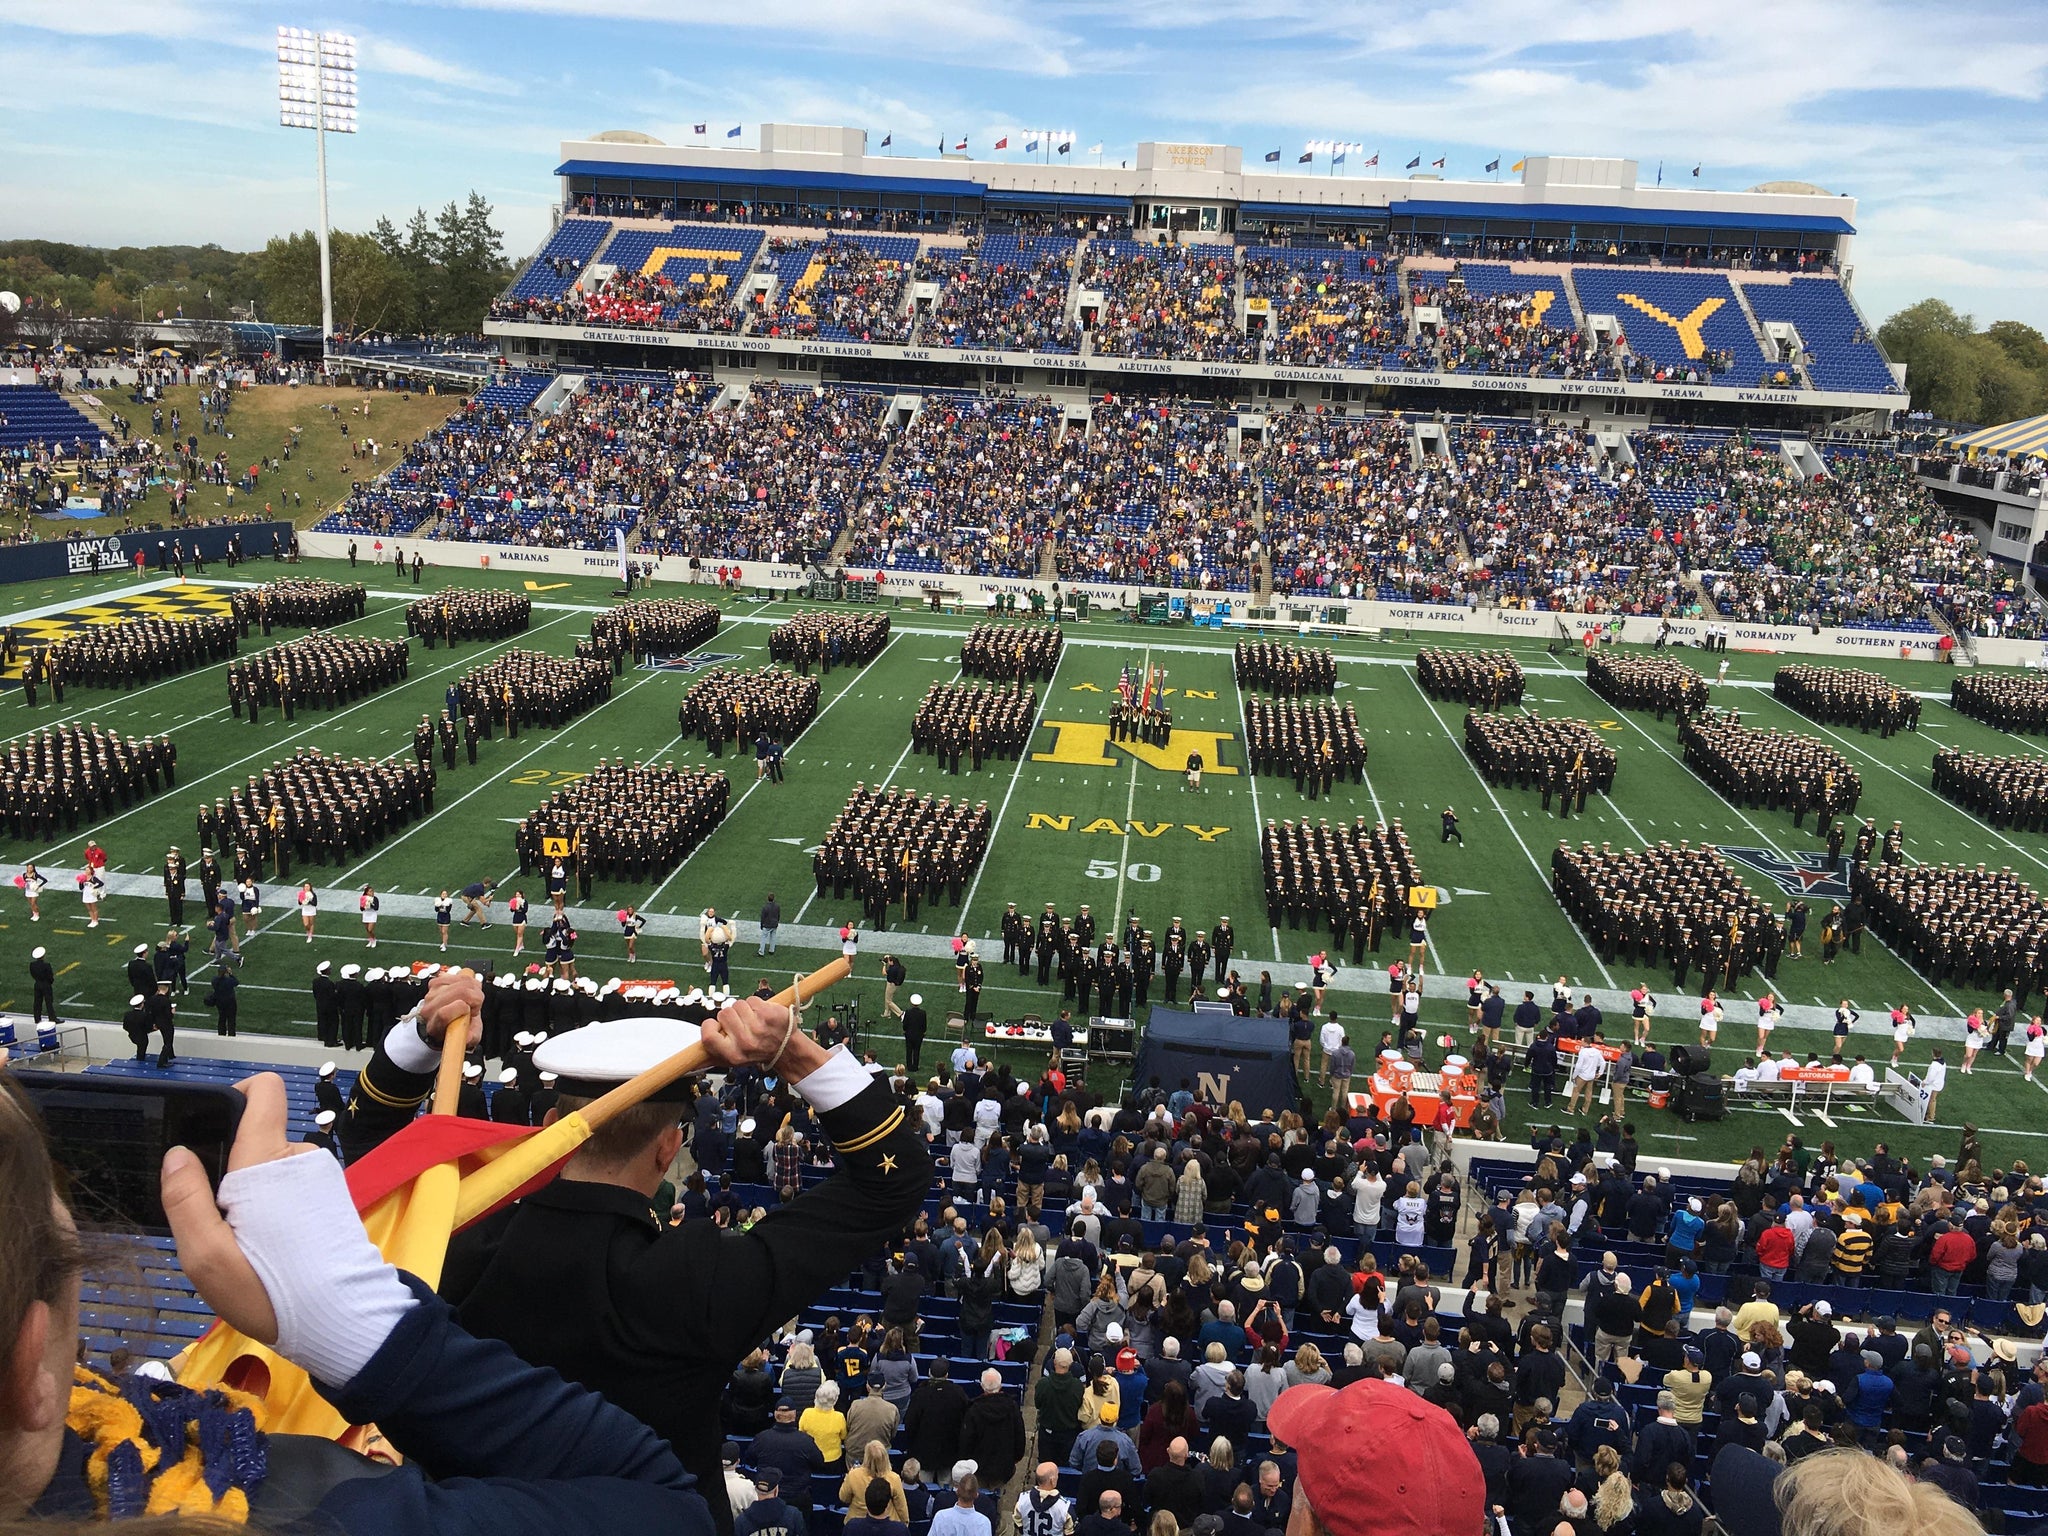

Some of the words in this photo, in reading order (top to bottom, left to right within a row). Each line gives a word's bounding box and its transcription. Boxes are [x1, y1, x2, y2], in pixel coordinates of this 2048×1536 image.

[1166, 146, 1213, 156] AKERSON
[1172, 157, 1206, 166] TOWER
[583, 331, 670, 344] CHATEAU-THIERRY
[697, 339, 738, 348] BELLEAU
[742, 341, 771, 350] WOOD
[801, 345, 831, 354] PEARL
[834, 347, 872, 356] HARBOR
[903, 351, 930, 359] WAKE
[959, 354, 982, 362] JAVA
[985, 355, 1003, 364] SEA
[1033, 358, 1065, 366] CORAL
[1068, 360, 1087, 368] SEA
[1117, 363, 1172, 372] ALEUTIANS
[1202, 367, 1242, 376] MIDWAY
[1274, 371, 1344, 381] GUADALCANAL
[1374, 375, 1400, 383] SAVO
[1403, 377, 1441, 386] ISLAND
[1471, 380, 1528, 390] SOLOMONS
[1560, 384, 1584, 392] NEW
[1587, 386, 1626, 395] GUINEA
[1661, 389, 1703, 398] TARAWA
[1738, 392, 1798, 403] KWAJALEIN
[67, 540, 106, 556] NAVY
[499, 552, 549, 562] MARIANAS
[771, 570, 801, 579] LEYTE
[979, 583, 999, 592] IWO
[1004, 586, 1027, 594] JIMA
[1389, 609, 1423, 619] NORTH
[1427, 612, 1464, 621] AFRICA
[1503, 616, 1538, 625] SICILY
[1669, 626, 1696, 635] NZIO
[1735, 630, 1797, 641] NORMANDY
[1836, 636, 1895, 647] SOUTHERN
[1028, 719, 1244, 776] N
[507, 769, 586, 786] 27
[1024, 813, 1231, 842] NAVY
[550, 842, 562, 853] A
[1084, 859, 1162, 882] 50
[1416, 891, 1429, 903] V
[1197, 1072, 1230, 1104] N
[1919, 1089, 1929, 1100] 27
[844, 1358, 860, 1377] 12
[1027, 1510, 1053, 1536] 12
